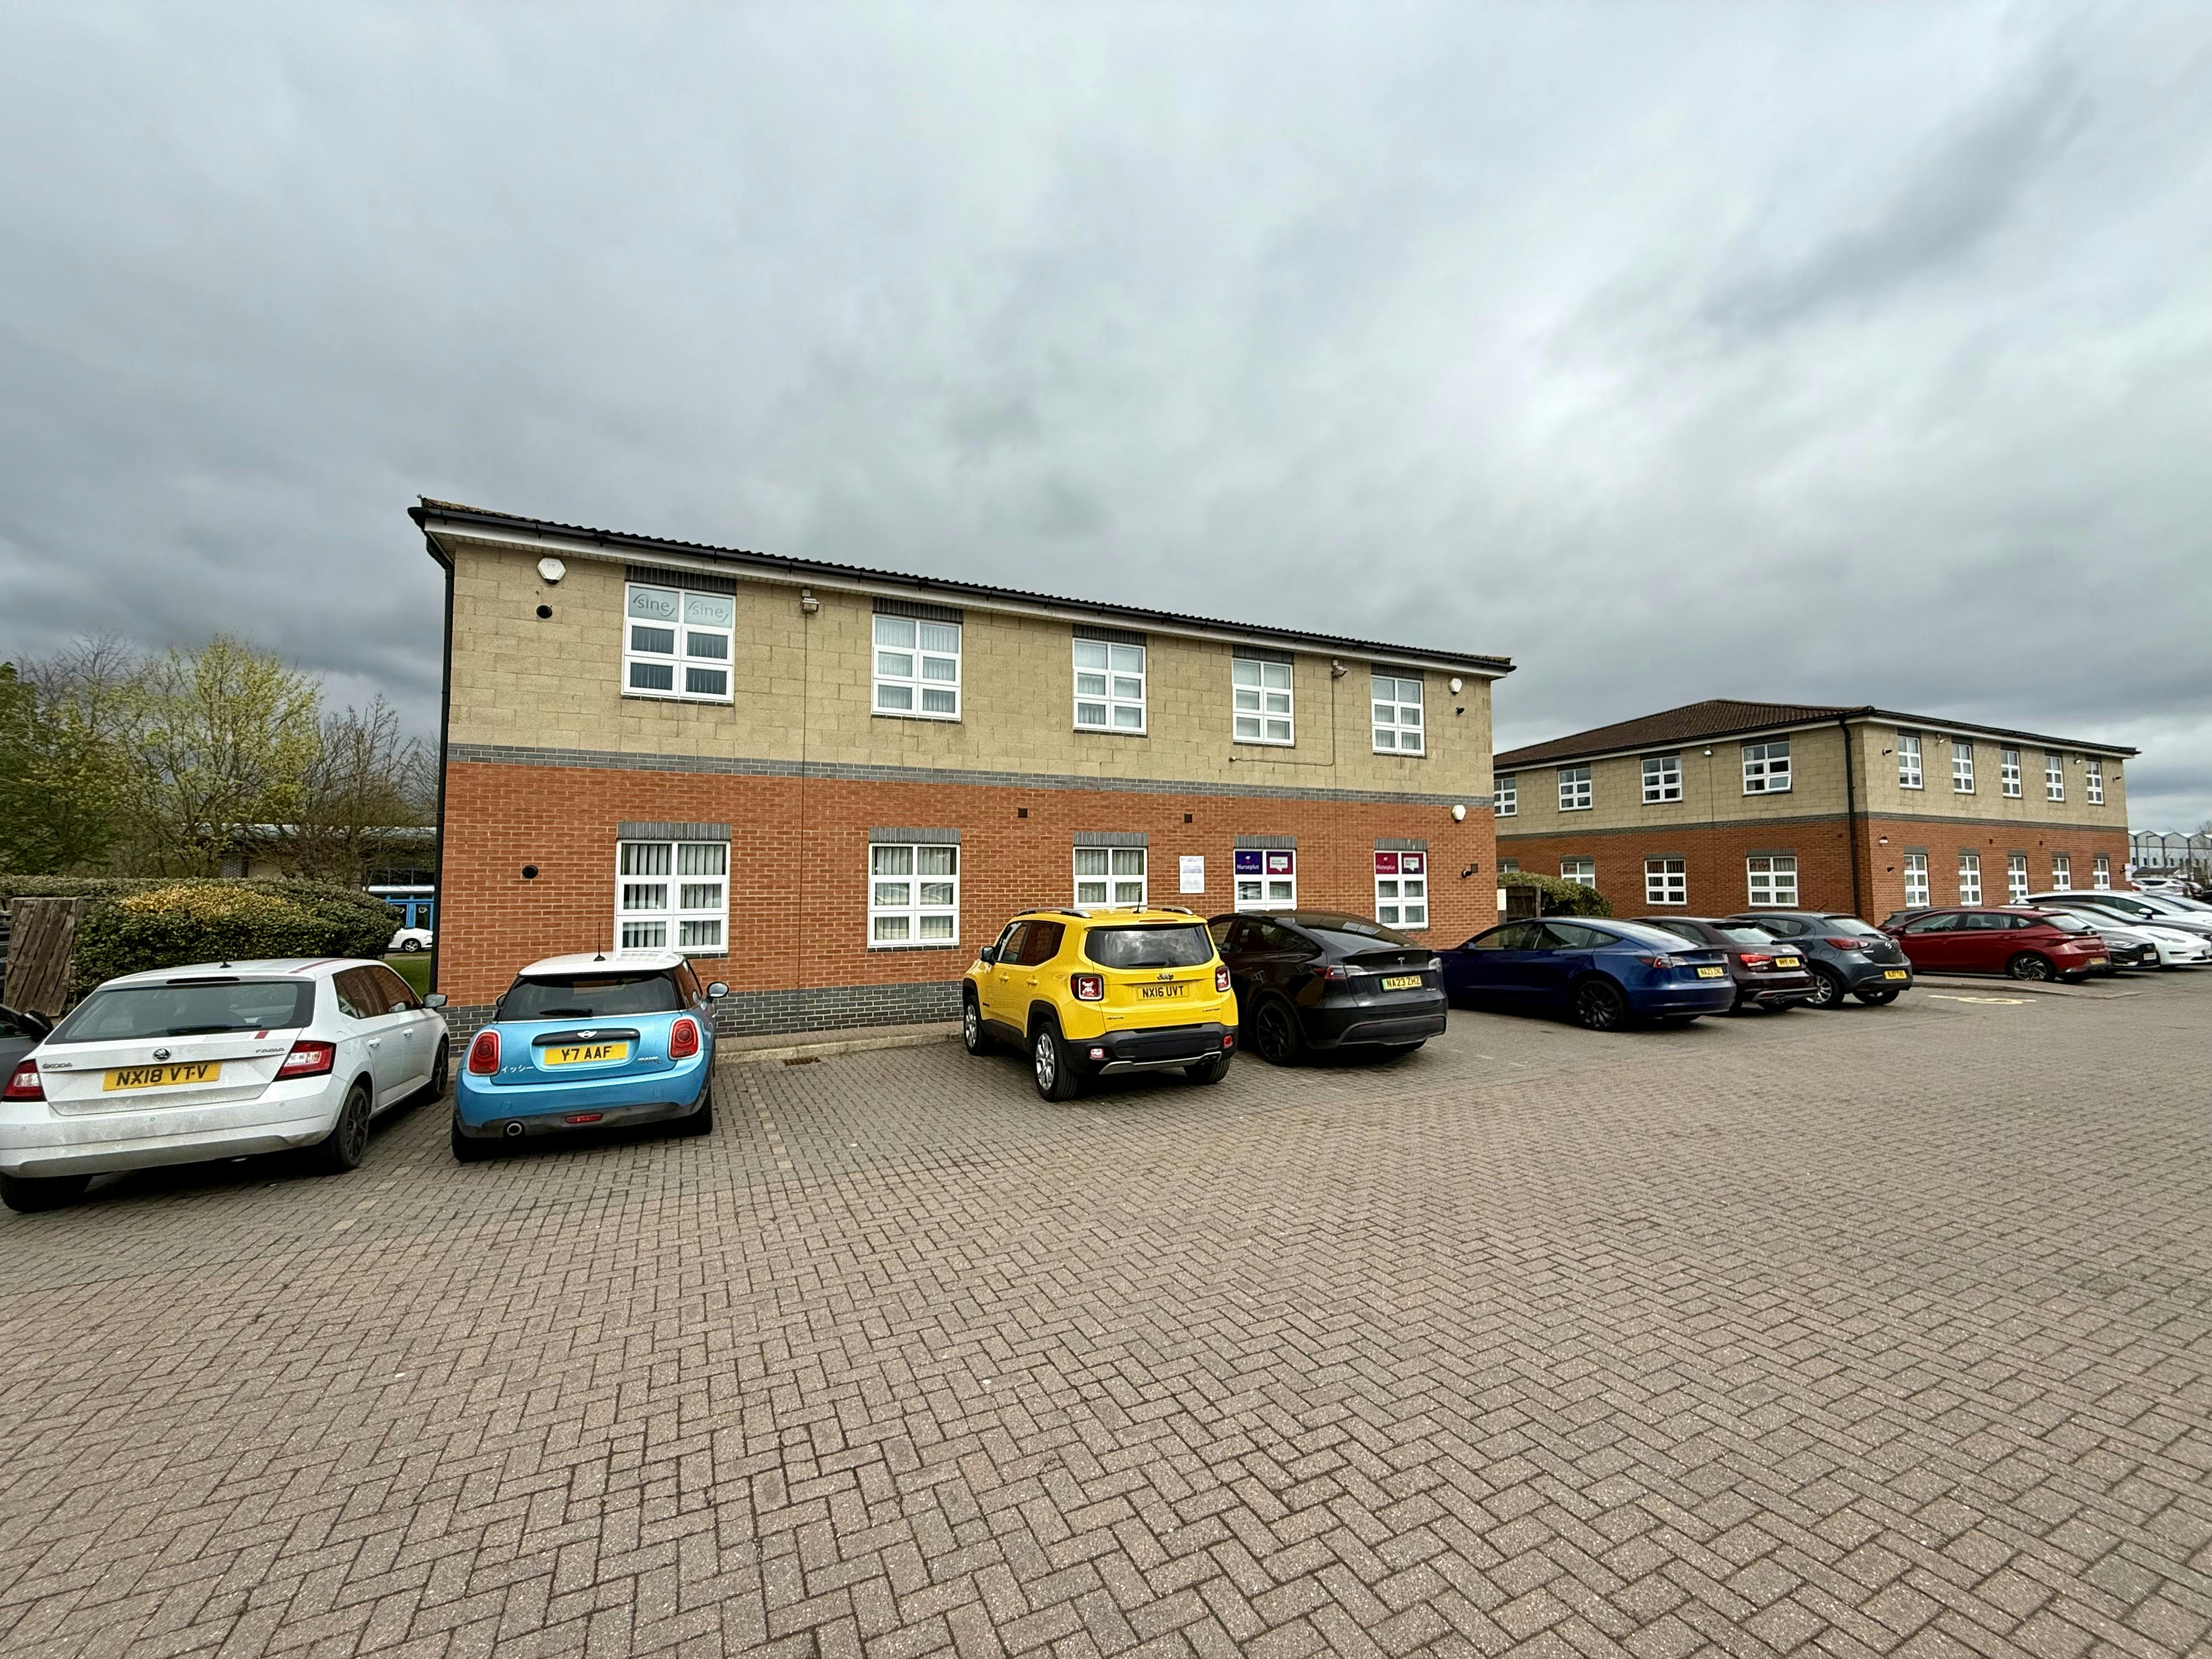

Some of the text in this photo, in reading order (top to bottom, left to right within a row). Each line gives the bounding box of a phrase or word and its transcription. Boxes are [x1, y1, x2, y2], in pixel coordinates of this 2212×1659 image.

[637, 597, 670, 612] sine
[692, 604, 723, 618] sine
[1386, 977, 1420, 988] NA23 ZHZ
[1142, 985, 1184, 998] NX16 UVT
[561, 1046, 612, 1061] Y7 AAF
[116, 1064, 208, 1086] NX18 VTV
